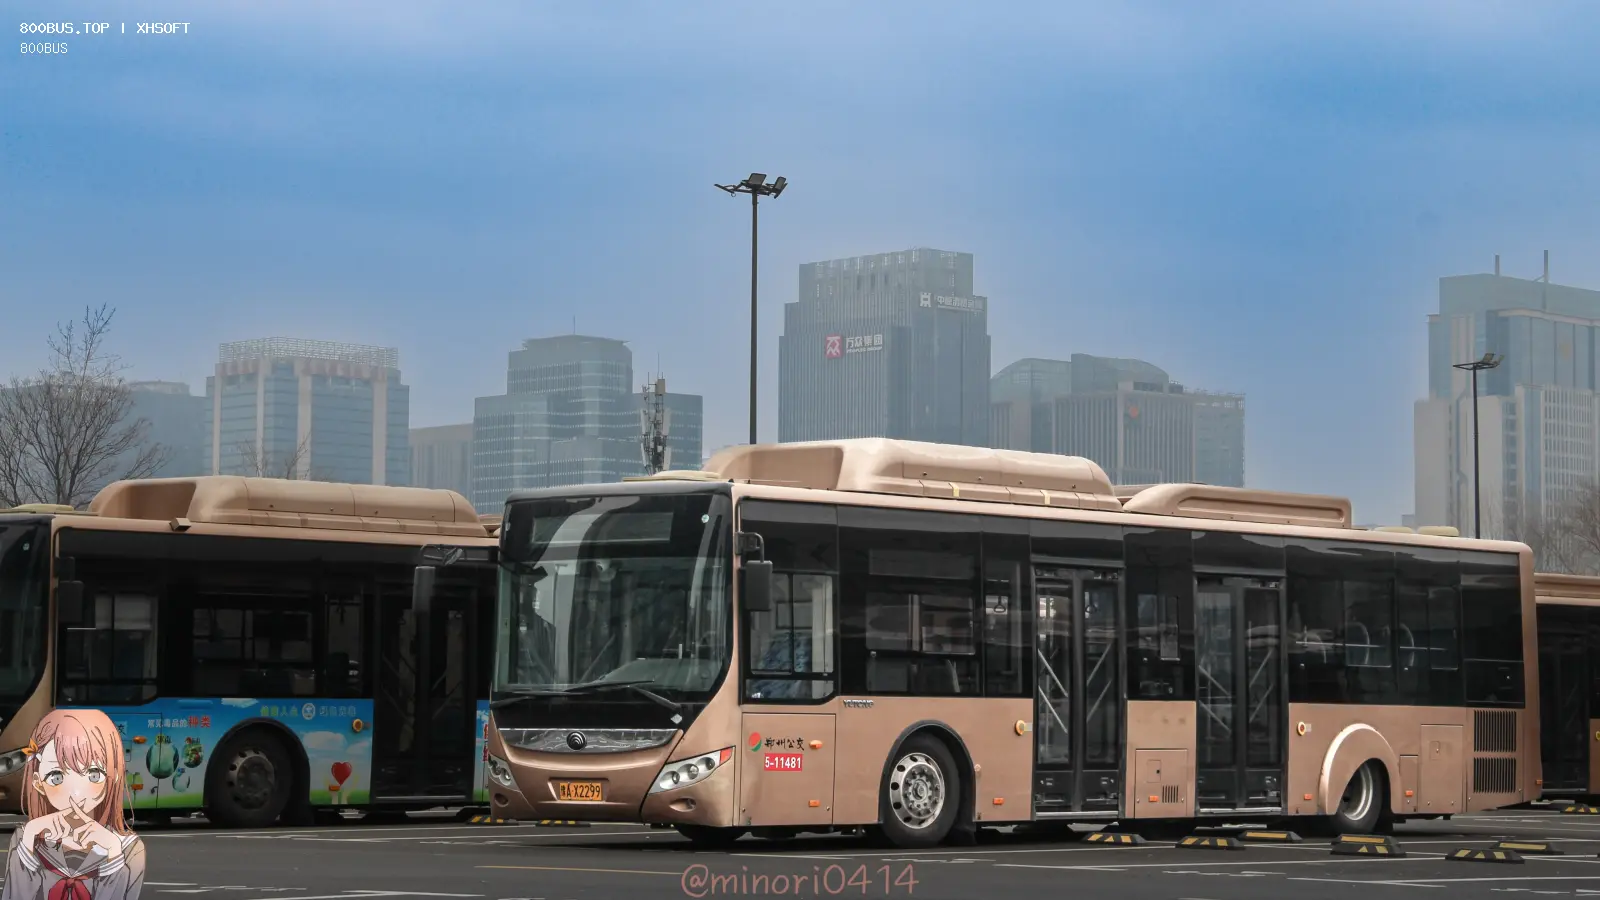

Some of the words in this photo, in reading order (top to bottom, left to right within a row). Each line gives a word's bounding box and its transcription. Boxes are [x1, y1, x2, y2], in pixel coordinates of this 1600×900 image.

[764, 737, 805, 751] 郑州公交
[765, 756, 801, 769] 5-11481
